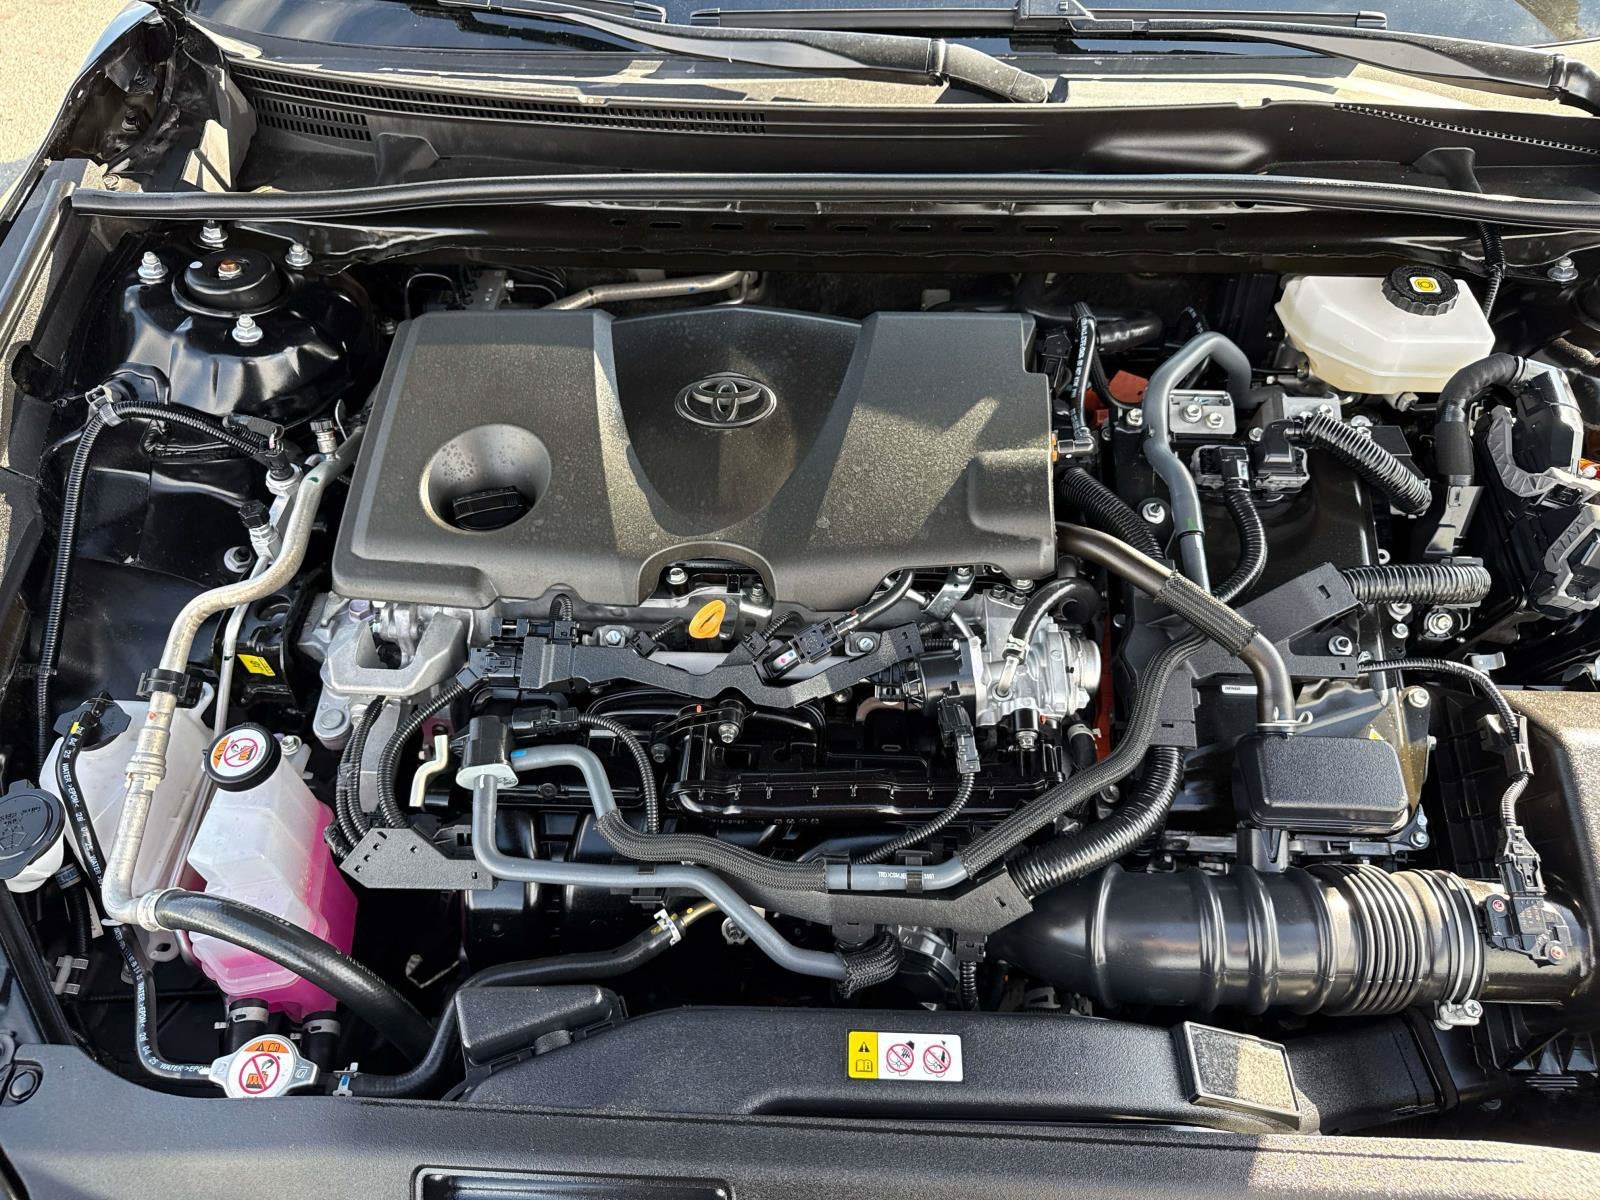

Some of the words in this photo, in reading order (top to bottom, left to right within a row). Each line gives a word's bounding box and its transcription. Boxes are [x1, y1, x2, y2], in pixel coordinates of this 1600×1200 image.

[62, 763, 72, 783] WATER
[90, 855, 102, 875] WATER
[137, 981, 146, 1002] WATER
[160, 1063, 183, 1072] WATER
